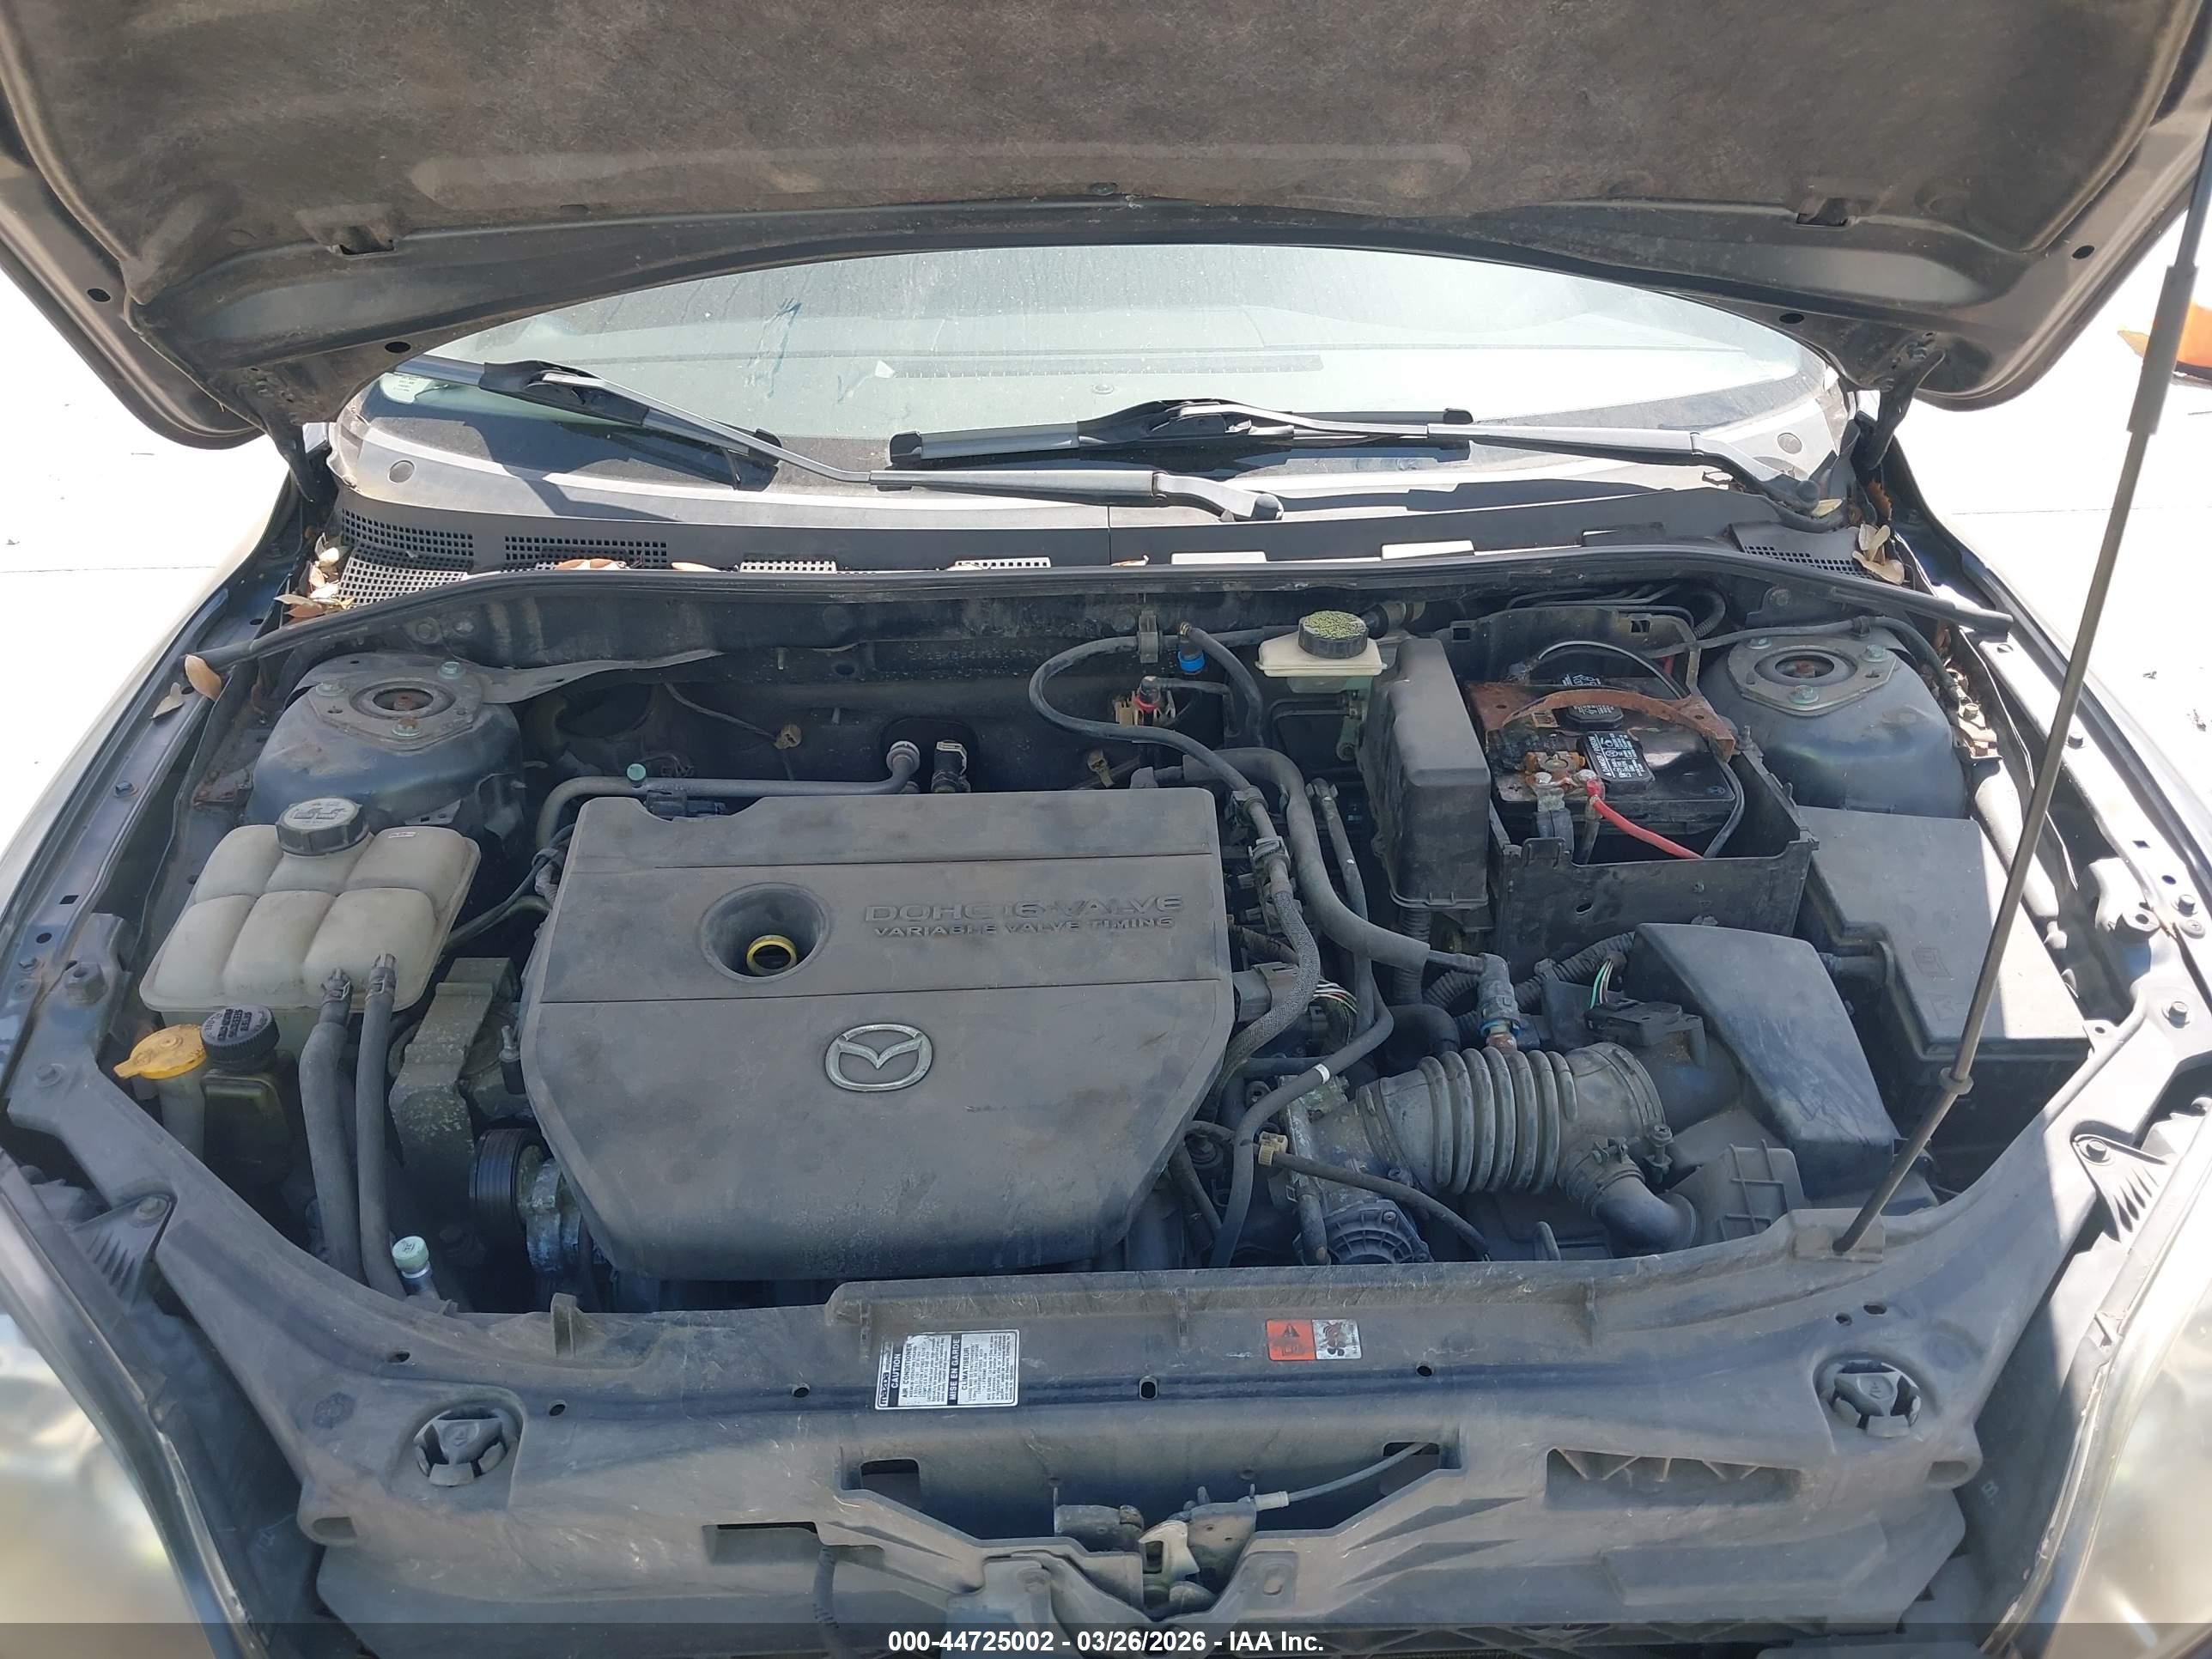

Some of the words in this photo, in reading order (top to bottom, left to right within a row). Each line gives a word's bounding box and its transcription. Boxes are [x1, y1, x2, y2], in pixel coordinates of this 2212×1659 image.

[865, 903, 994, 921] DOHC
[874, 925, 997, 938] VARIABLE
[1005, 920, 1079, 934] VALVE
[1089, 916, 1175, 929] TIMING
[903, 1343, 913, 1385] CONDITIONER
[951, 1339, 960, 1366] GARDE
[891, 1353, 902, 1389] CAUTION
[951, 1367, 958, 1379] EN
[962, 1347, 970, 1391] CLIMATISEUR
